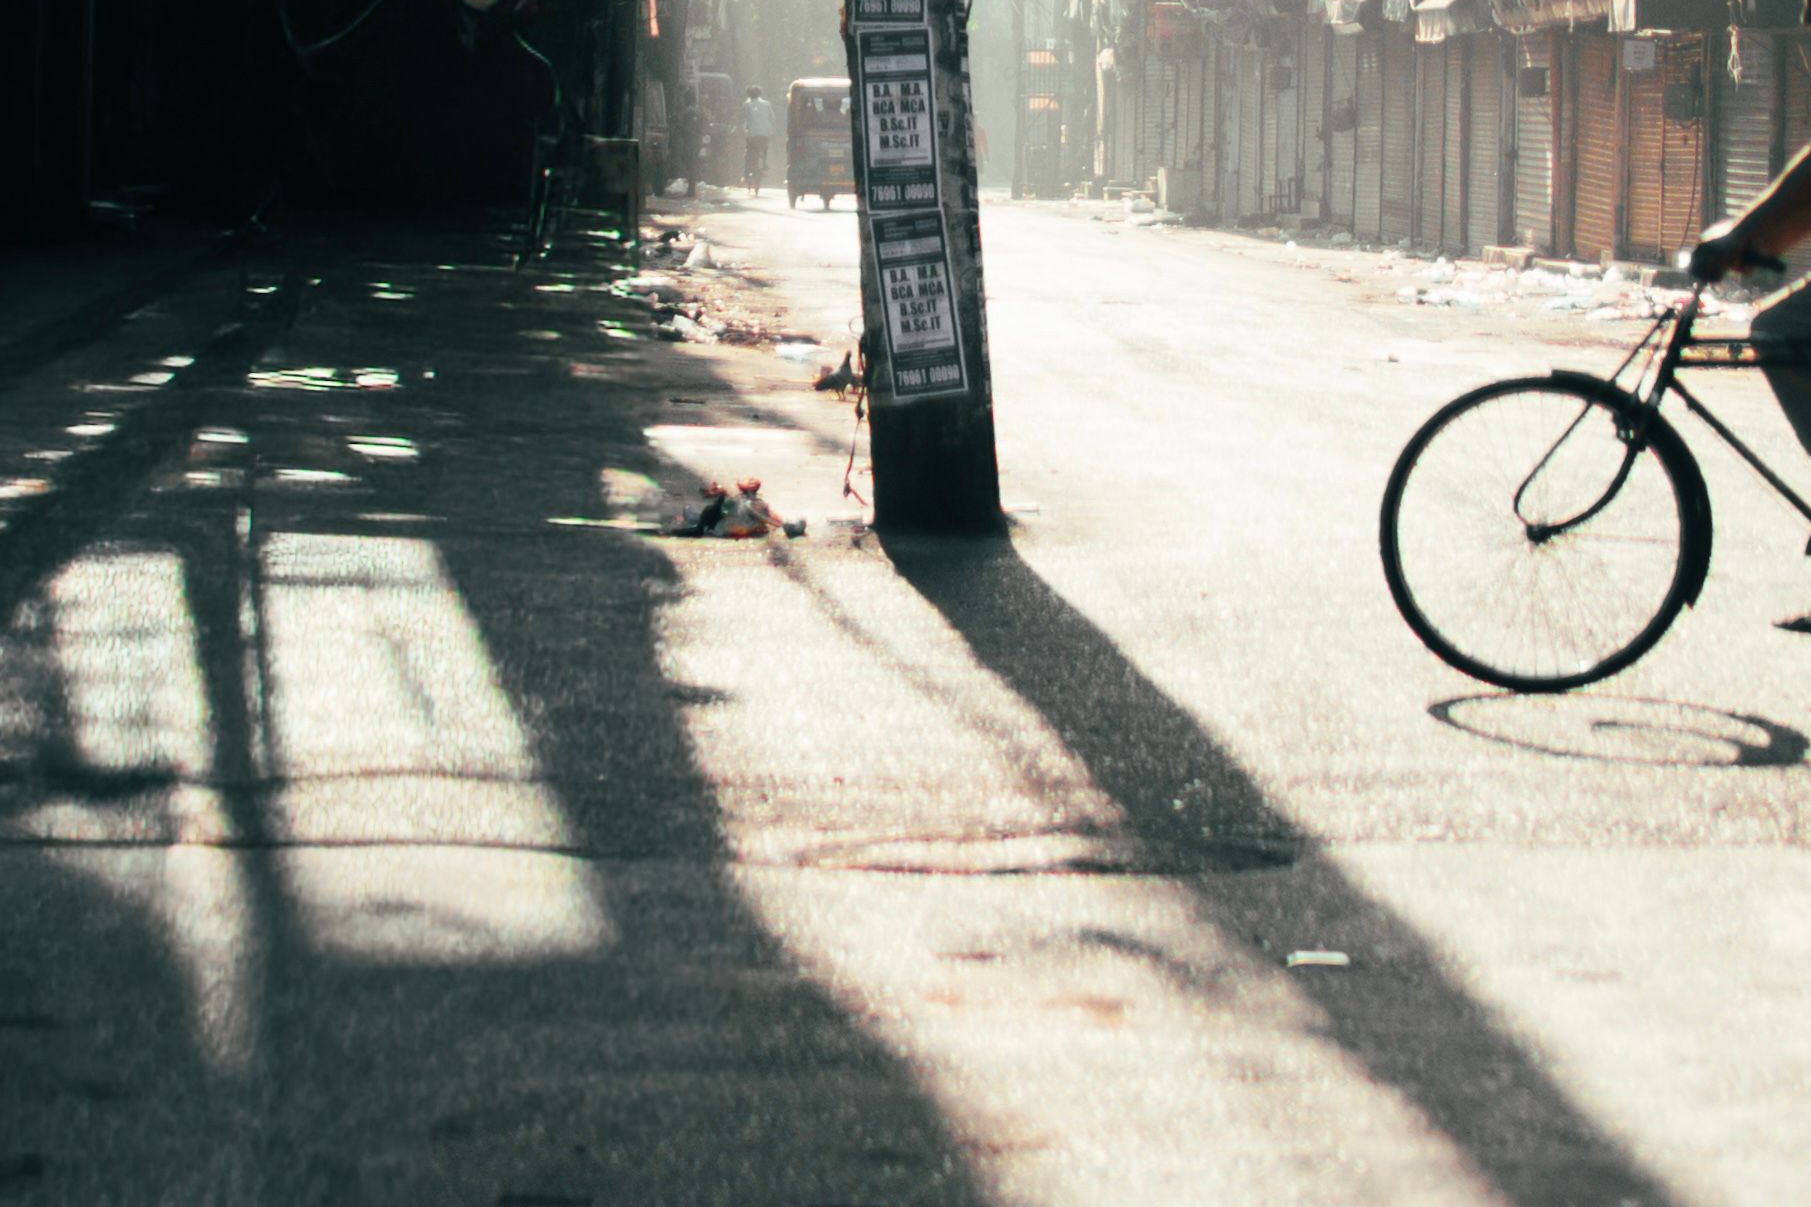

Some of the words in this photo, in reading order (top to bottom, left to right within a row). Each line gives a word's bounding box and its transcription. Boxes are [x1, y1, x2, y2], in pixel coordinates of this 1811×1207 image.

[873, 83, 892, 98] B.A.
[872, 100, 895, 115] BCA
[900, 98, 926, 113] MCA
[872, 185, 901, 202] 76961
[889, 268, 909, 284] B.A.
[891, 285, 914, 301] BCA
[918, 281, 945, 298] MCA
[897, 368, 927, 387] 76961
